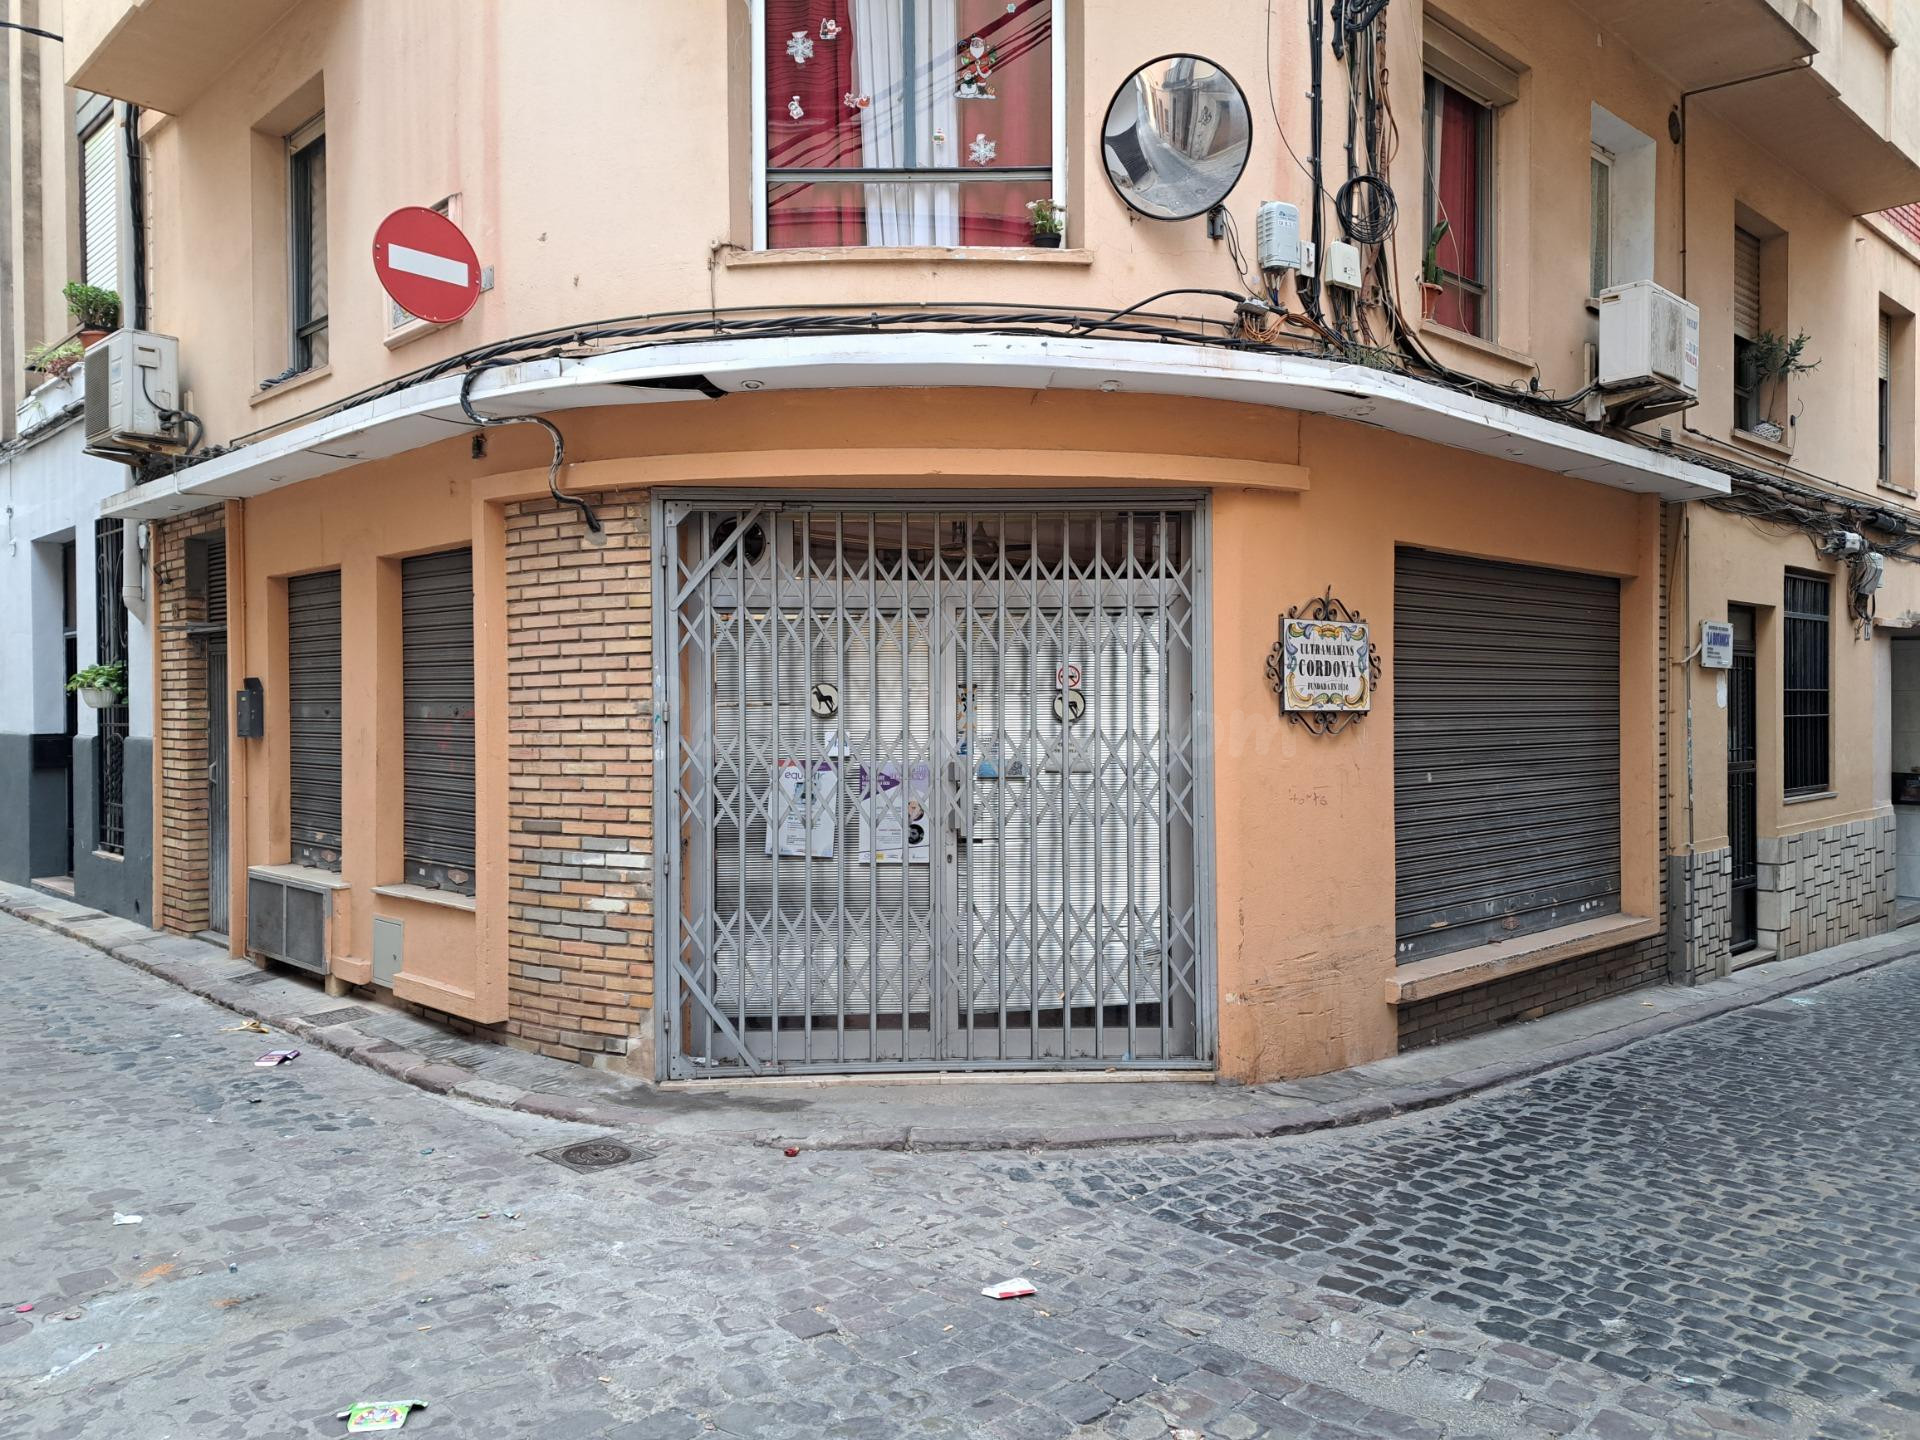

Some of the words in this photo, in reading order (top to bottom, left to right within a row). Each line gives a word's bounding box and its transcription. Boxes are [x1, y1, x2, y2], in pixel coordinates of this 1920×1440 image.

[1300, 643, 1354, 656] ULTRAMARINS
[1299, 659, 1356, 677] CORDOVA
[1308, 682, 1330, 690] FUNDADA
